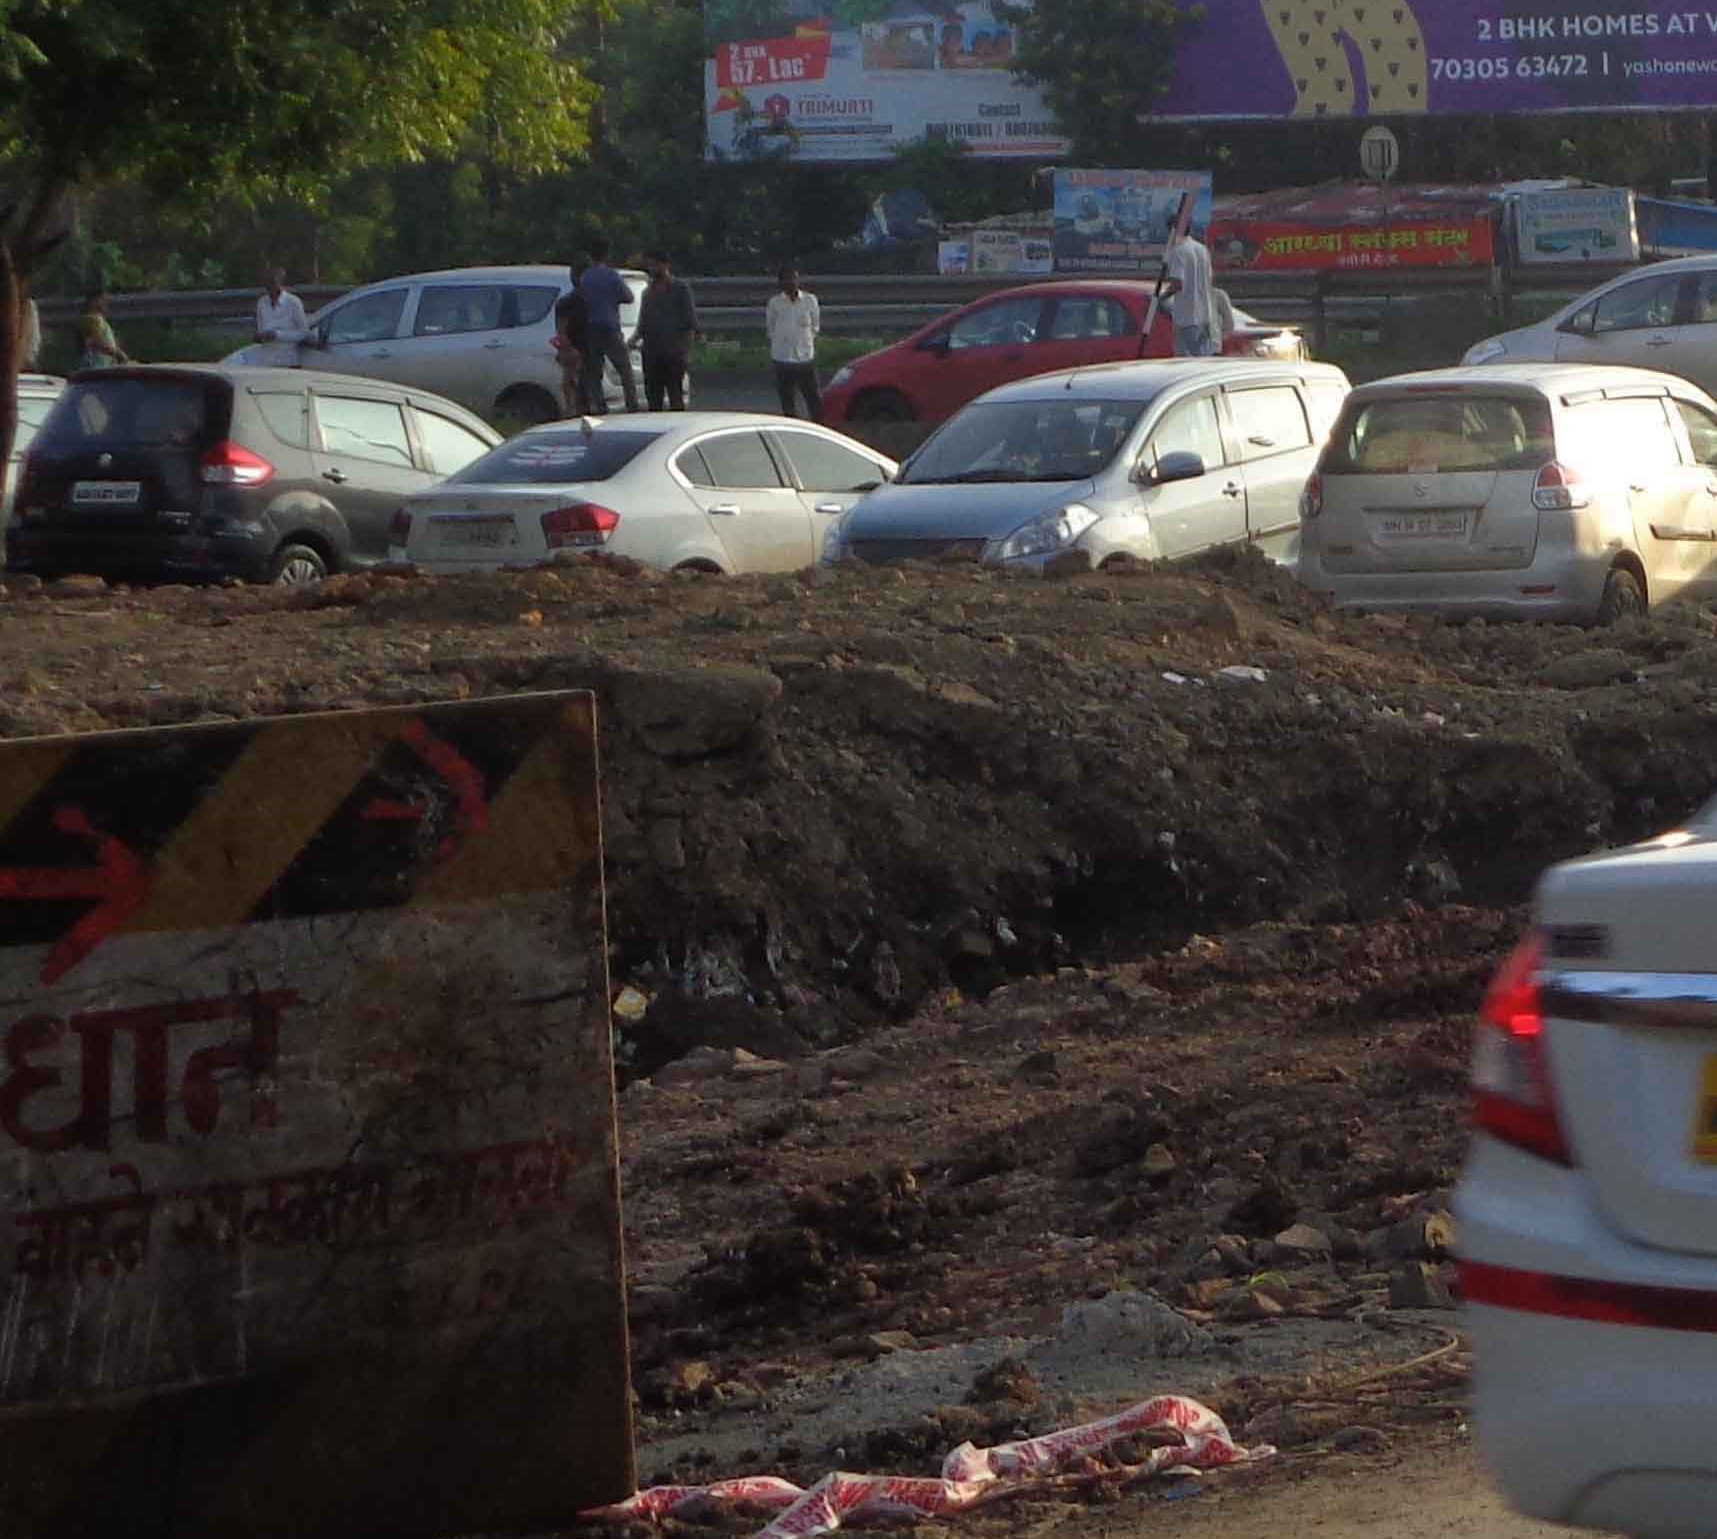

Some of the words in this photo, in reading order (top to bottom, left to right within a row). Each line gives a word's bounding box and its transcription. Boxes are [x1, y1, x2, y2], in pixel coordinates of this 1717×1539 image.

[1477, 20, 1492, 41] 2
[1499, 17, 1556, 40] BHK
[1562, 13, 1660, 38] HOMES
[1666, 12, 1700, 35] AT
[1430, 57, 1509, 81] 70305
[1515, 53, 1588, 78] 63472
